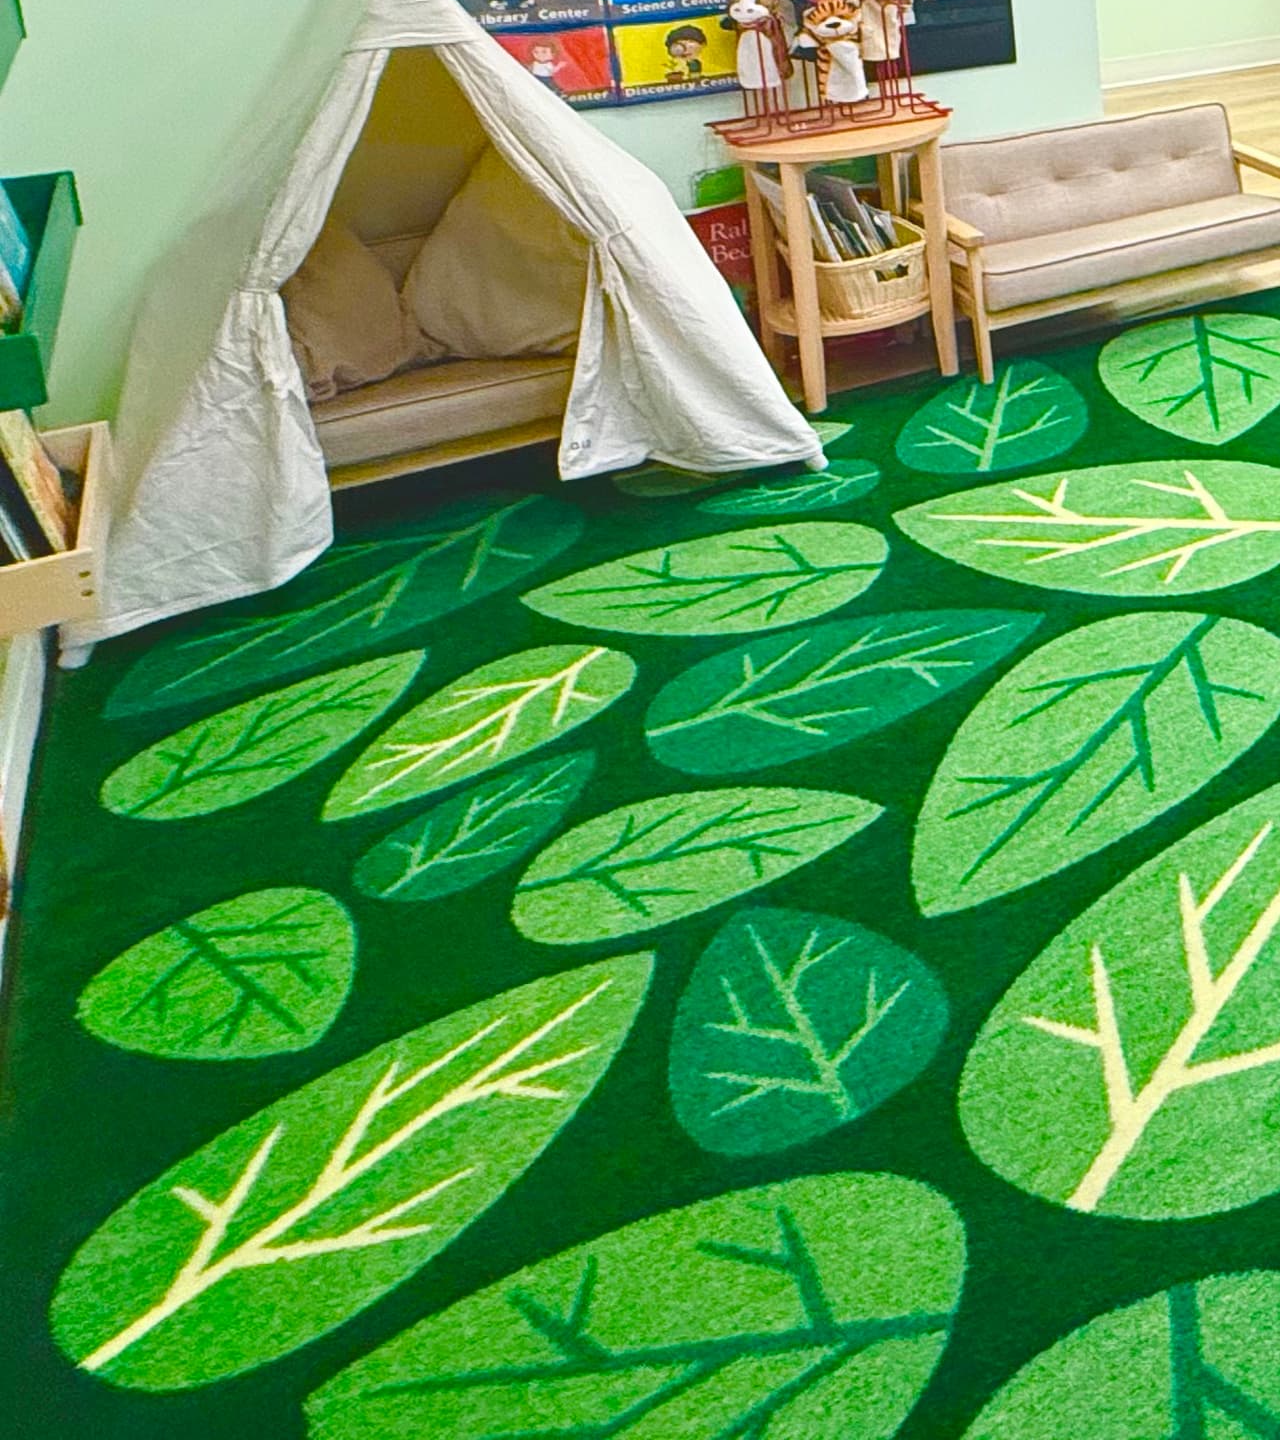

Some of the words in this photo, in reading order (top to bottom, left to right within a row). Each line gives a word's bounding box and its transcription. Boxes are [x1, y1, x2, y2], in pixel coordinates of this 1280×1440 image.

[538, 7, 589, 20] Center
[622, 0, 676, 14] Science
[624, 82, 695, 97] Discovery
